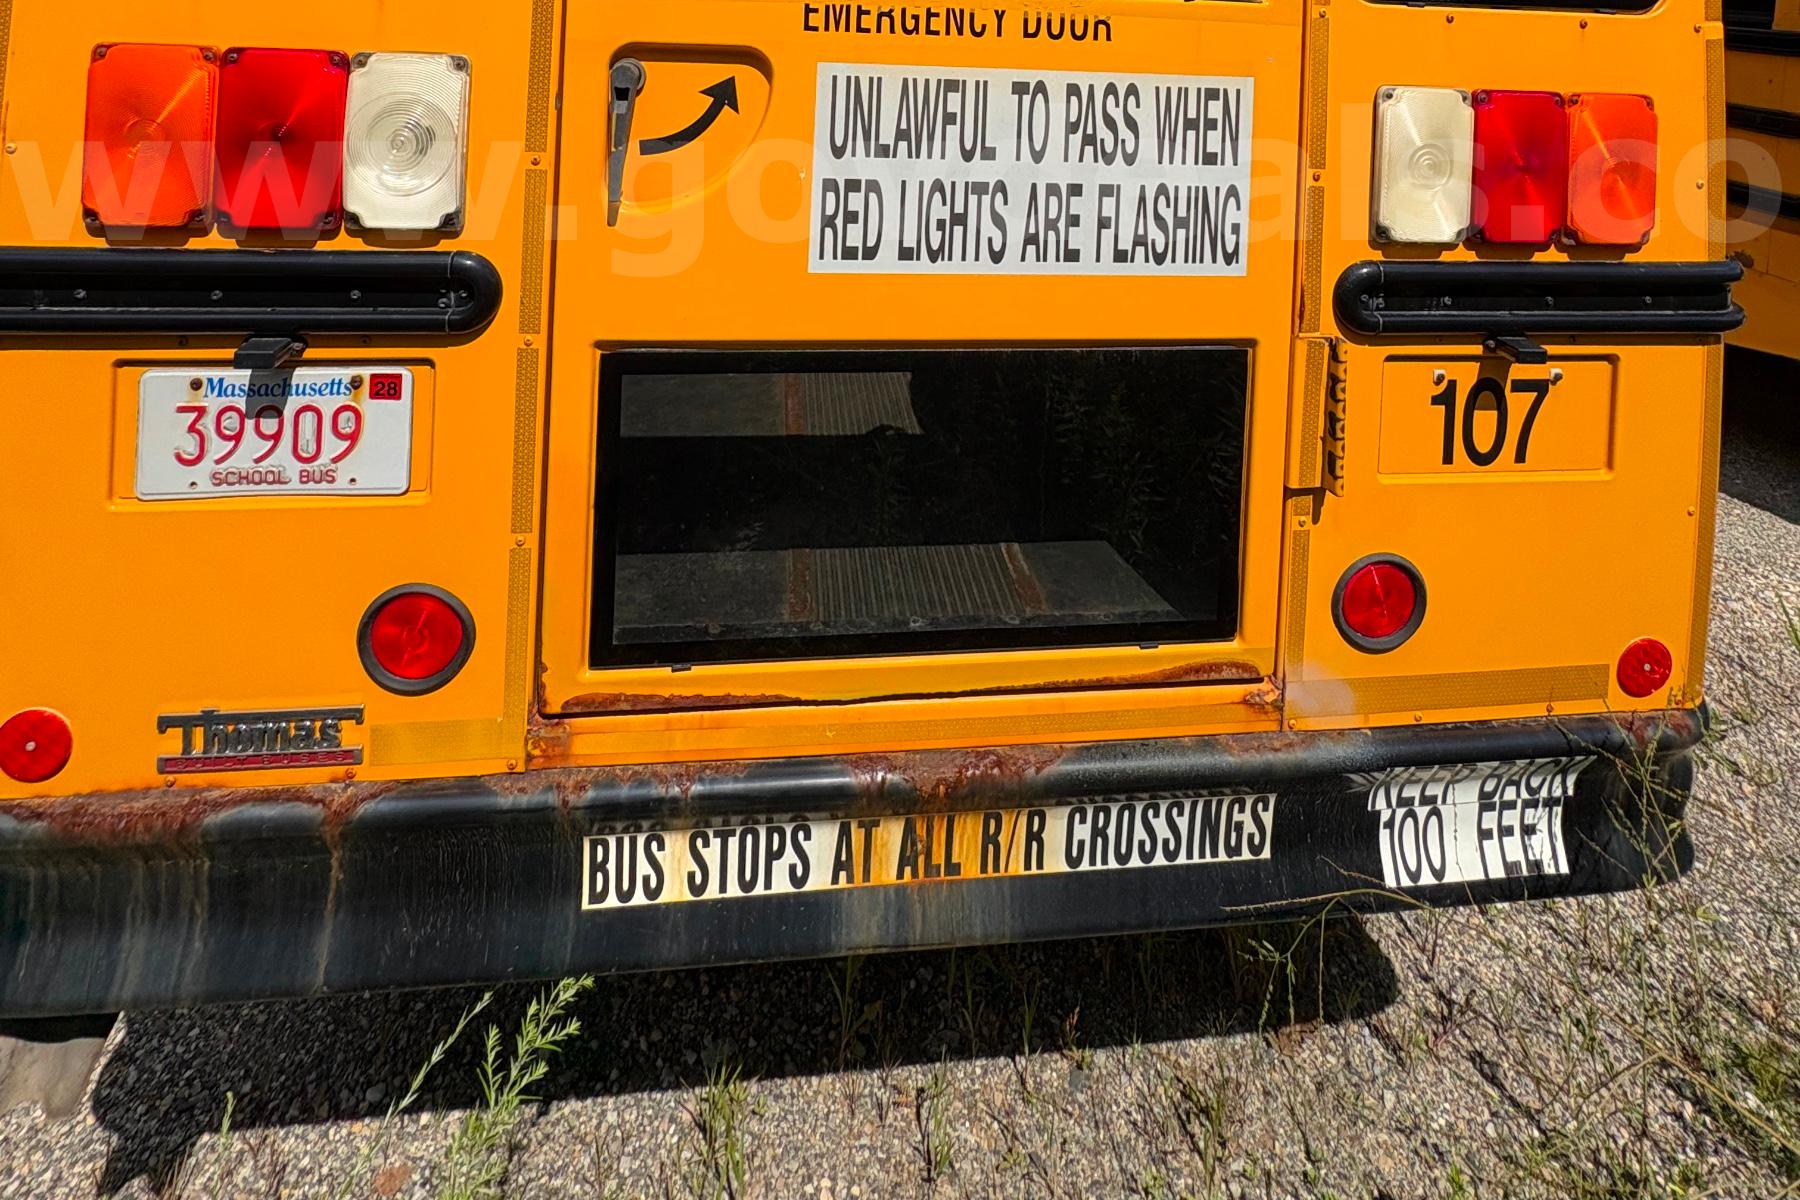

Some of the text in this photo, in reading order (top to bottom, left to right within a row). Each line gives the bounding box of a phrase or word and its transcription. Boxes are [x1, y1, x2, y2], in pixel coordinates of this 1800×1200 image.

[828, 74, 1242, 167] UNLAWFUL TO PASS WHEN
[818, 177, 1242, 267] RED LIGHTS ARE FLASHING
[203, 376, 353, 398] Massachusetts
[373, 382, 399, 398] 28
[1430, 376, 1551, 467] 107
[173, 404, 363, 467] 39909
[211, 467, 337, 487] SCHOOL BUS
[157, 704, 365, 756] Thomas
[587, 794, 1271, 906] BUS STOPS AT ALL R/R CROSSINGS
[1383, 796, 1565, 886] 100 FEET
